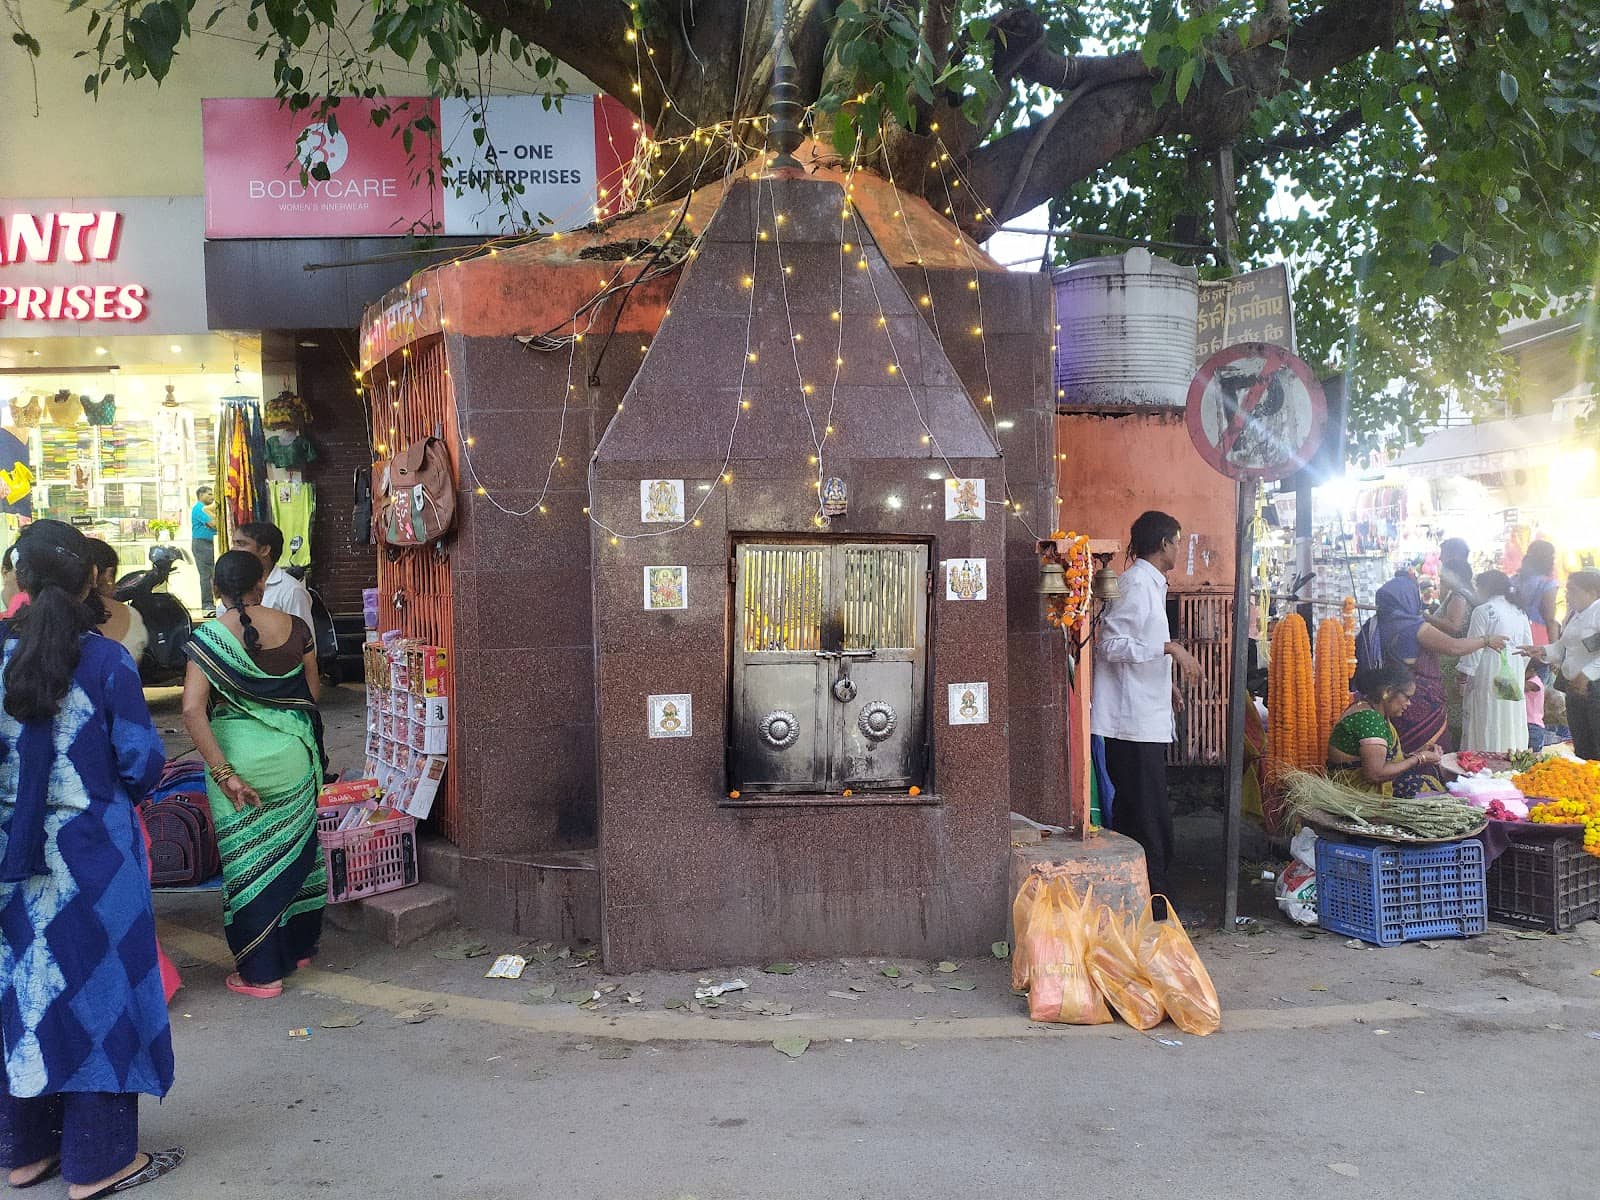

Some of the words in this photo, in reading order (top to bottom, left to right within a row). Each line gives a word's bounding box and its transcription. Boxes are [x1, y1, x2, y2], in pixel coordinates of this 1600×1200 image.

[513, 144, 553, 160] ONE
[458, 169, 581, 185] ENTERPRISES
[248, 178, 398, 199] BODYCARE
[0, 211, 119, 263] NTI
